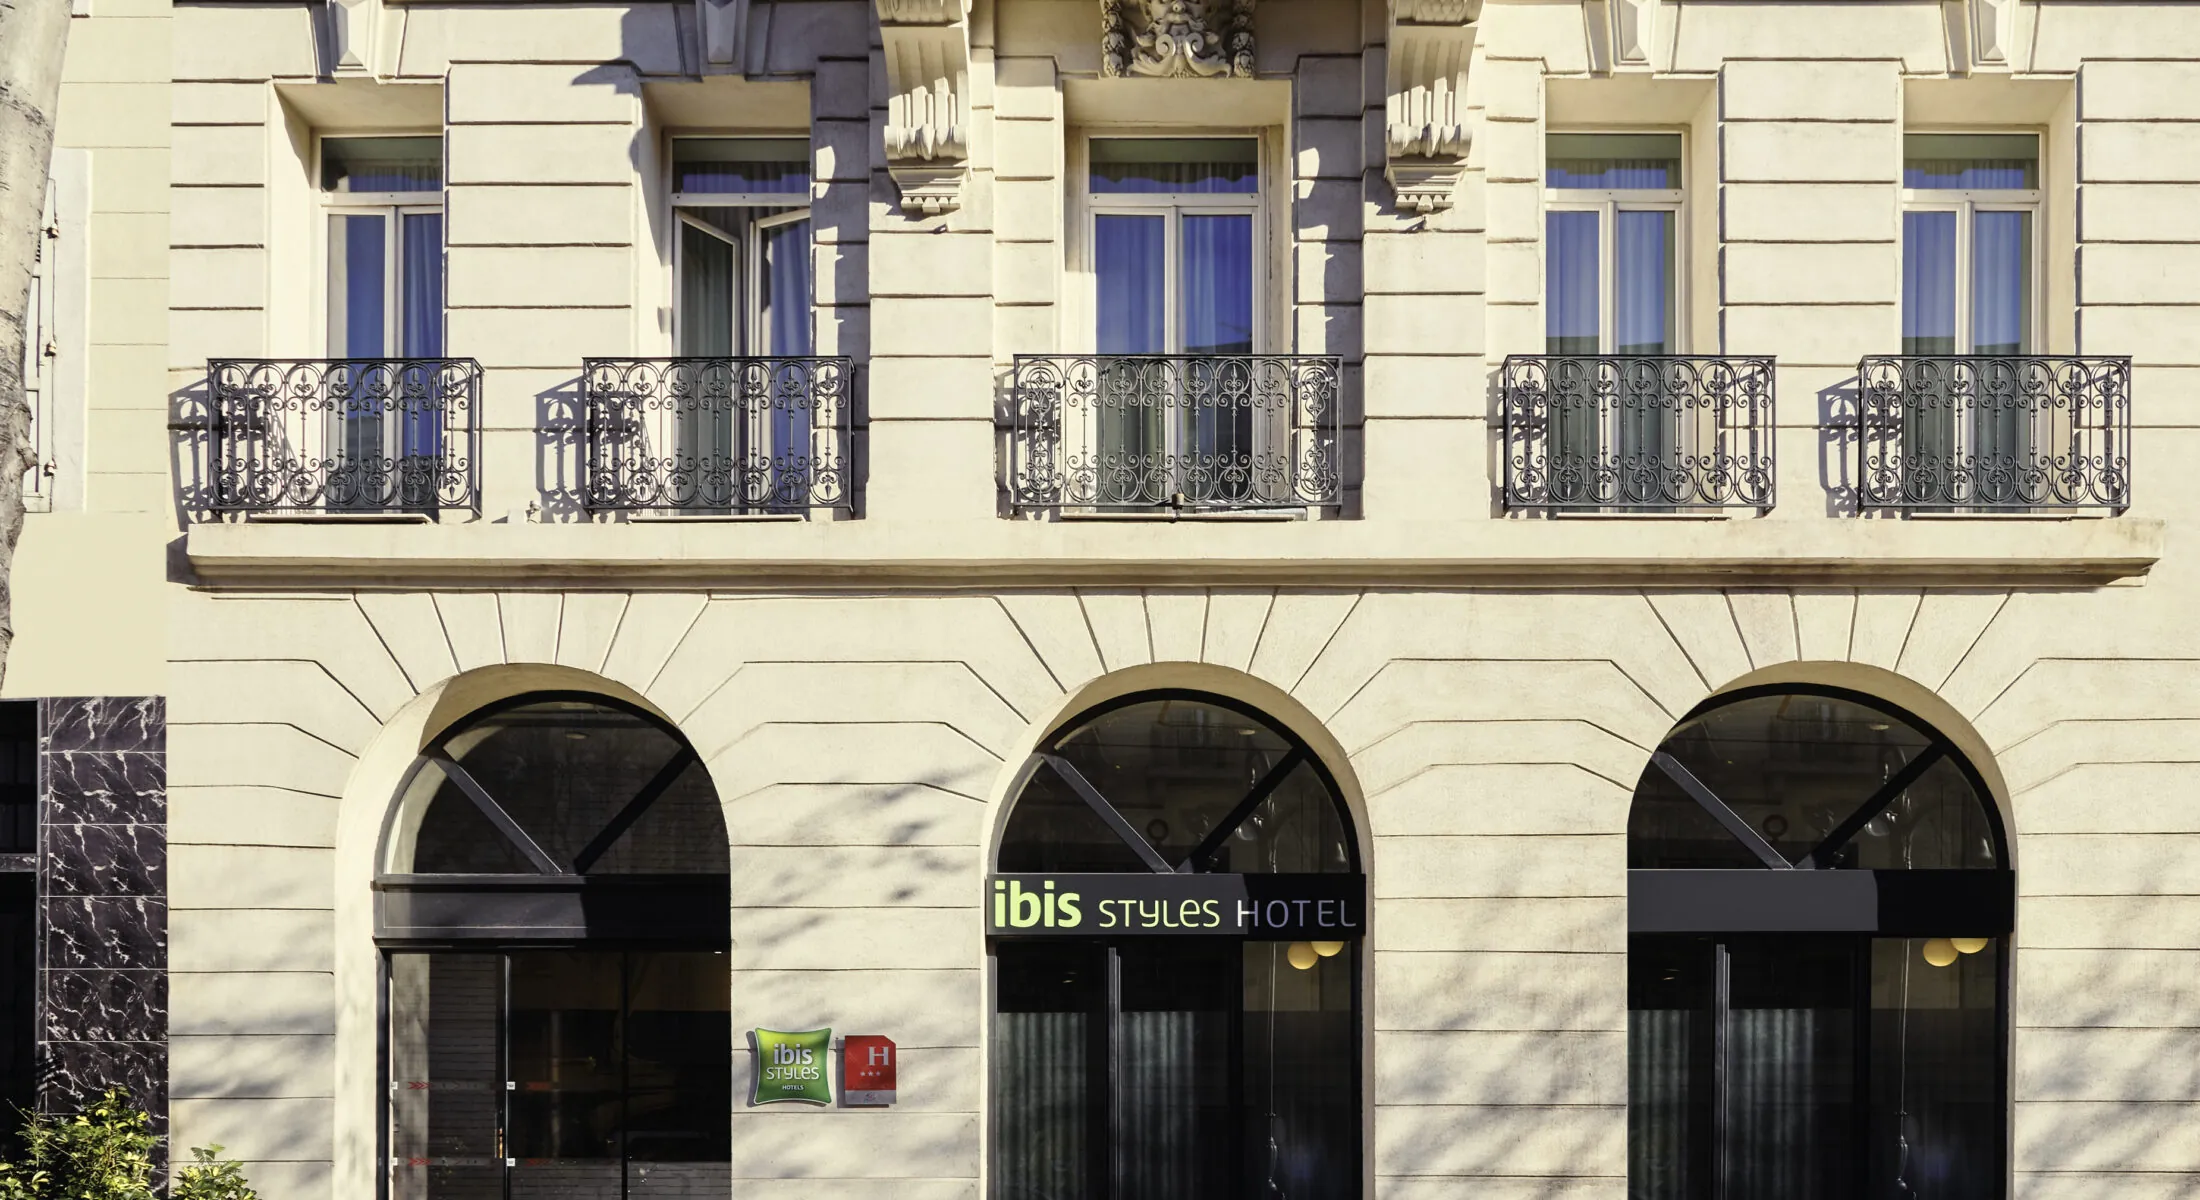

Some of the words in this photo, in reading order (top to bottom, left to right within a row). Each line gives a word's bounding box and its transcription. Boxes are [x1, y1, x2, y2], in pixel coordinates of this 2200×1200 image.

[994, 880, 1082, 928] ibis
[1236, 899, 1357, 928] HOTEL
[773, 1043, 813, 1065] ibis
[868, 1046, 889, 1066] H
